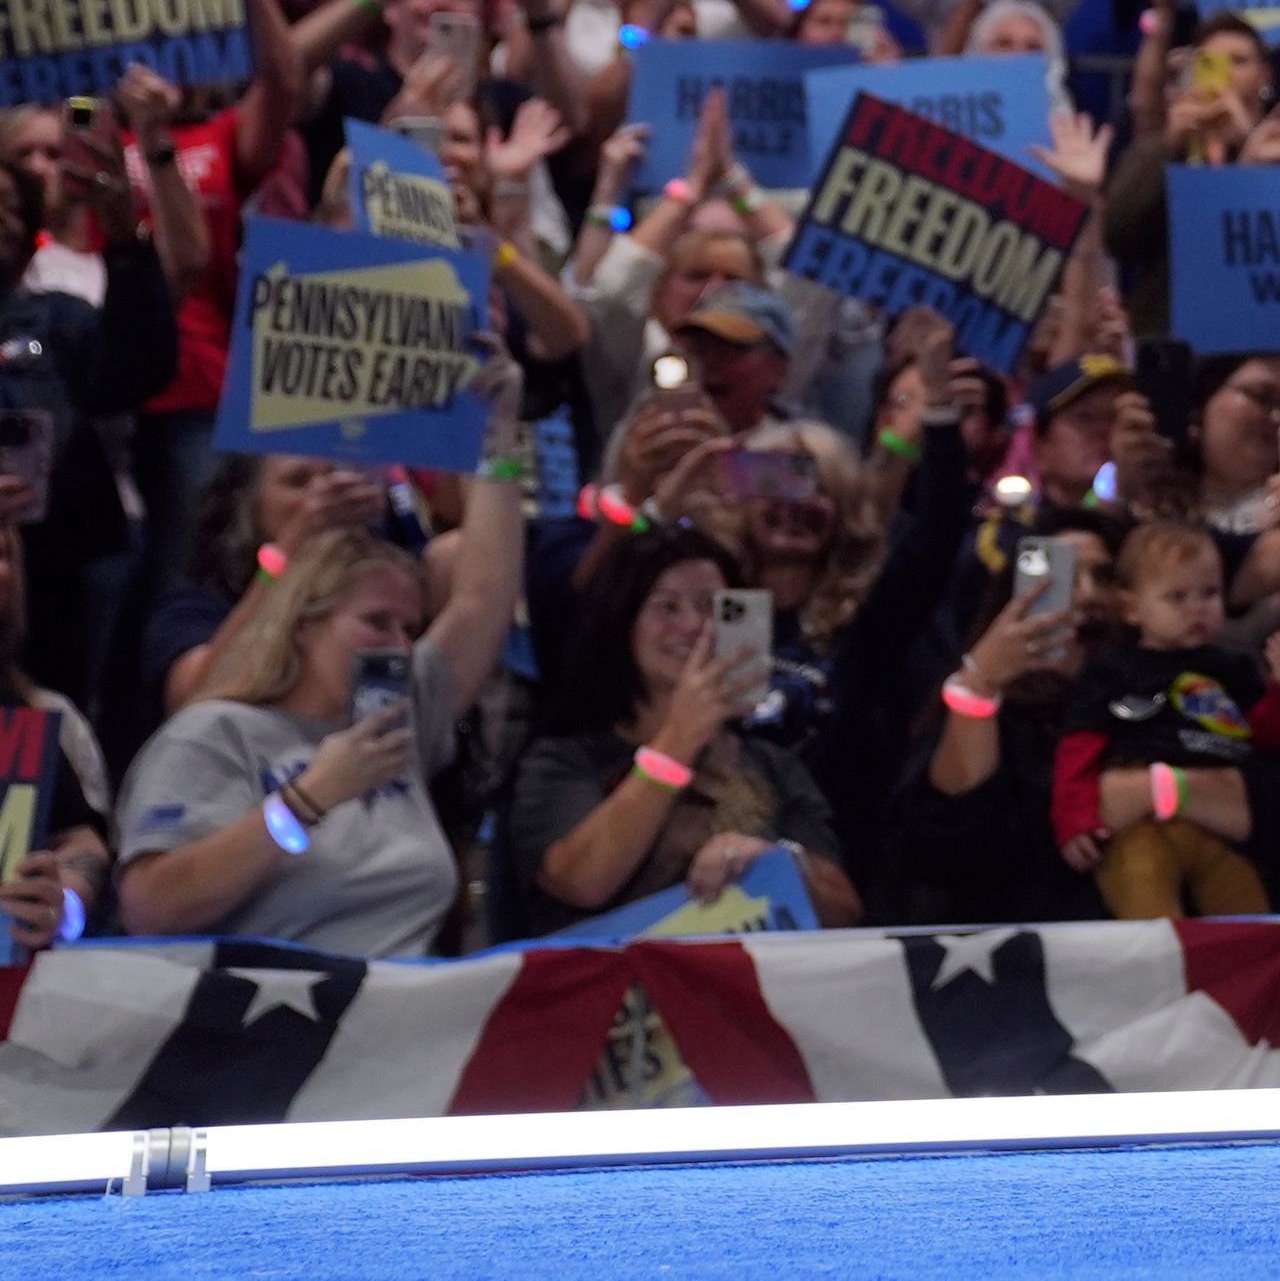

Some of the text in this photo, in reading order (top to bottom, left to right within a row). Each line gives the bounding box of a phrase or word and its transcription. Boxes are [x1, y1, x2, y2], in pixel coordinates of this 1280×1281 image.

[812, 146, 1064, 322] FREEDOM
[261, 336, 470, 414] VOTES EARLY
